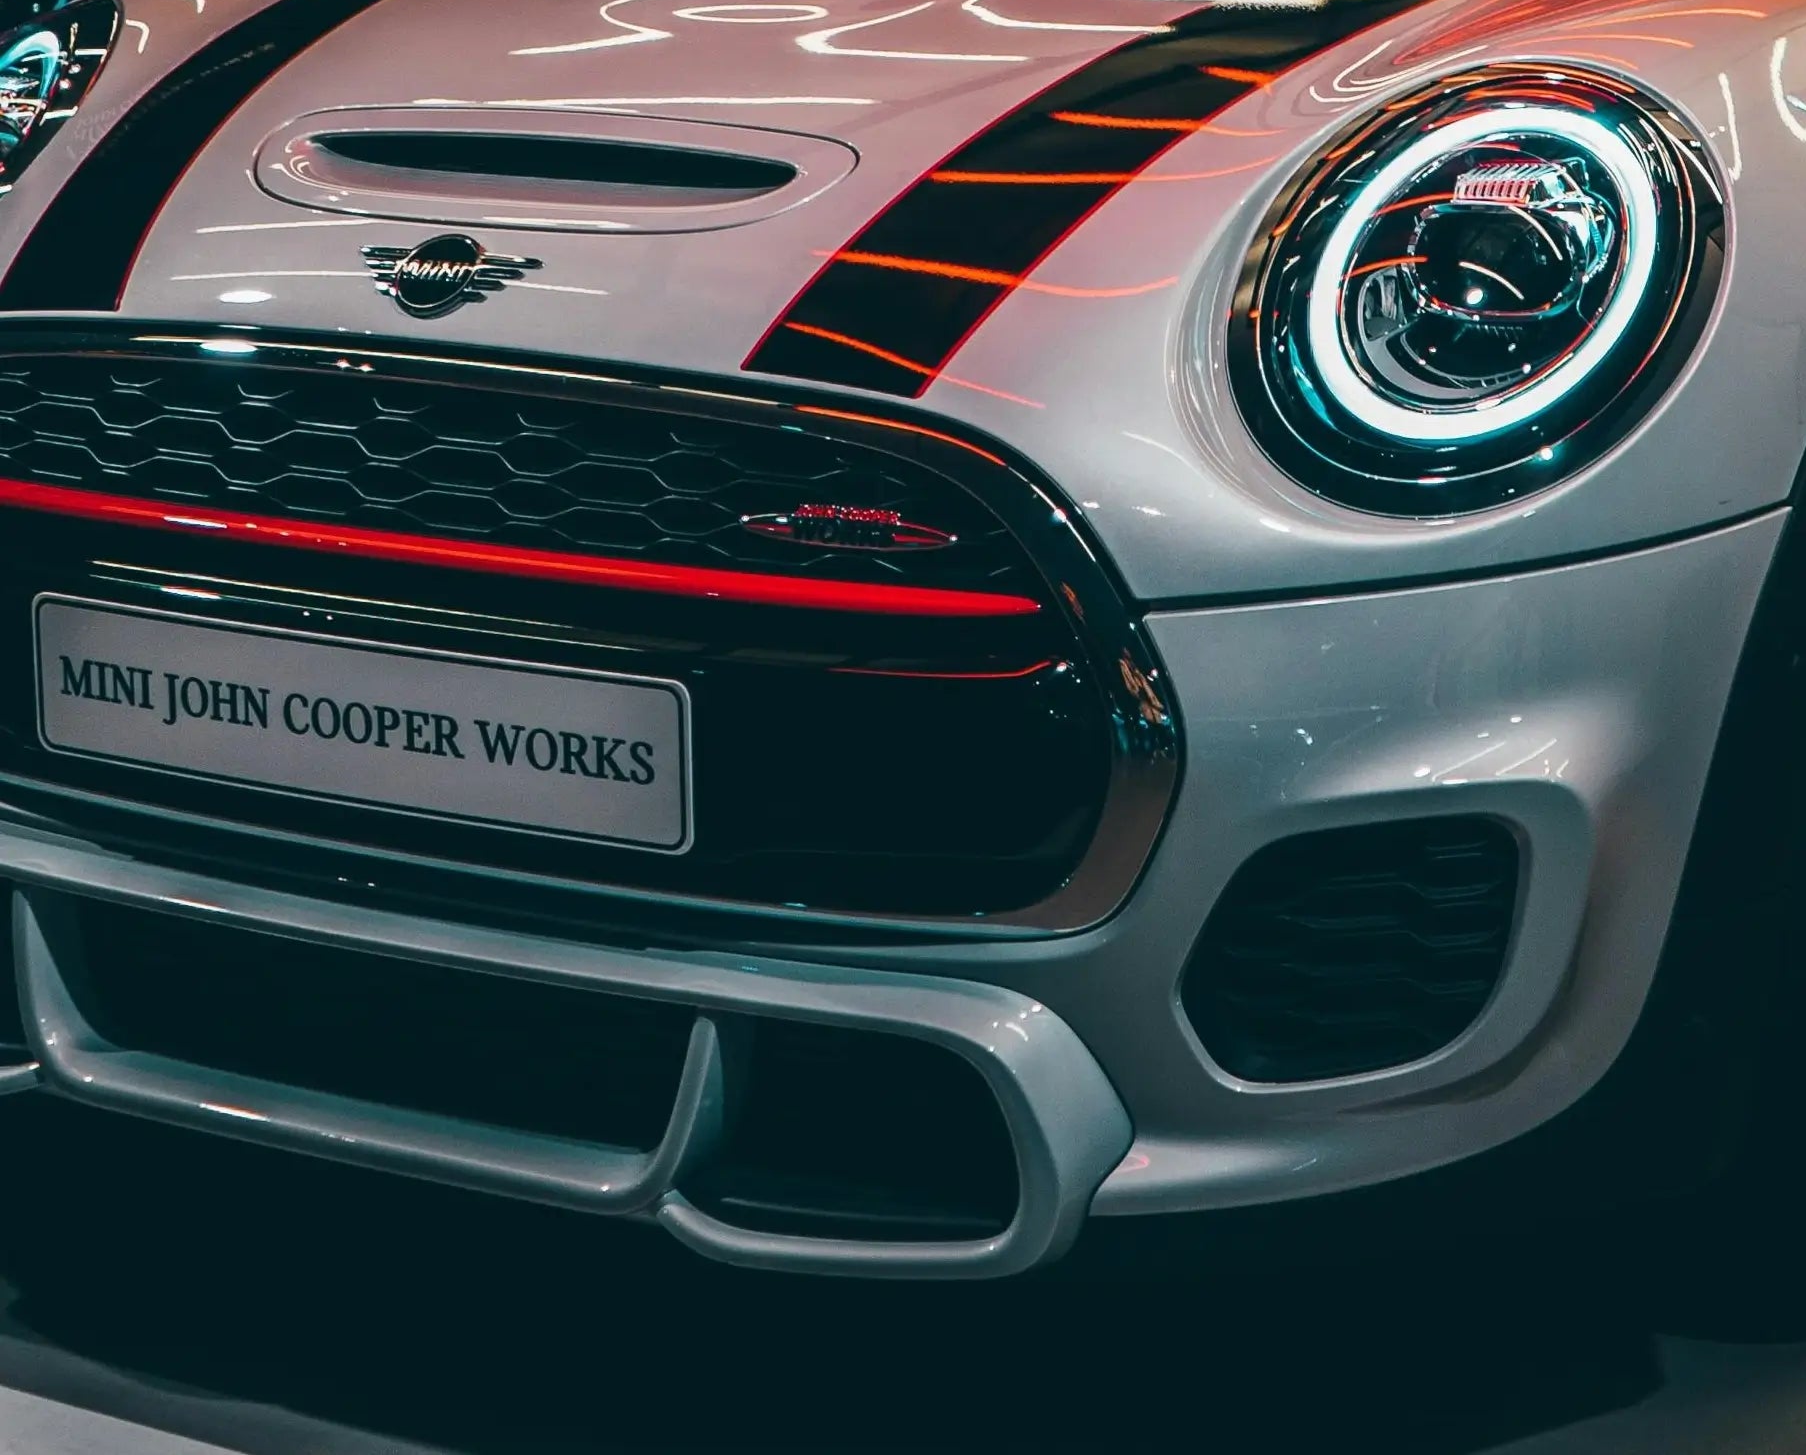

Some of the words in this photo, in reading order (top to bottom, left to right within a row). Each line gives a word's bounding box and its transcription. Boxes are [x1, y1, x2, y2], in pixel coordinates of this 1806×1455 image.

[58, 653, 155, 711] MINI
[162, 672, 271, 730] JOHN
[282, 692, 466, 760] COOPER
[473, 719, 656, 786] WORKS
